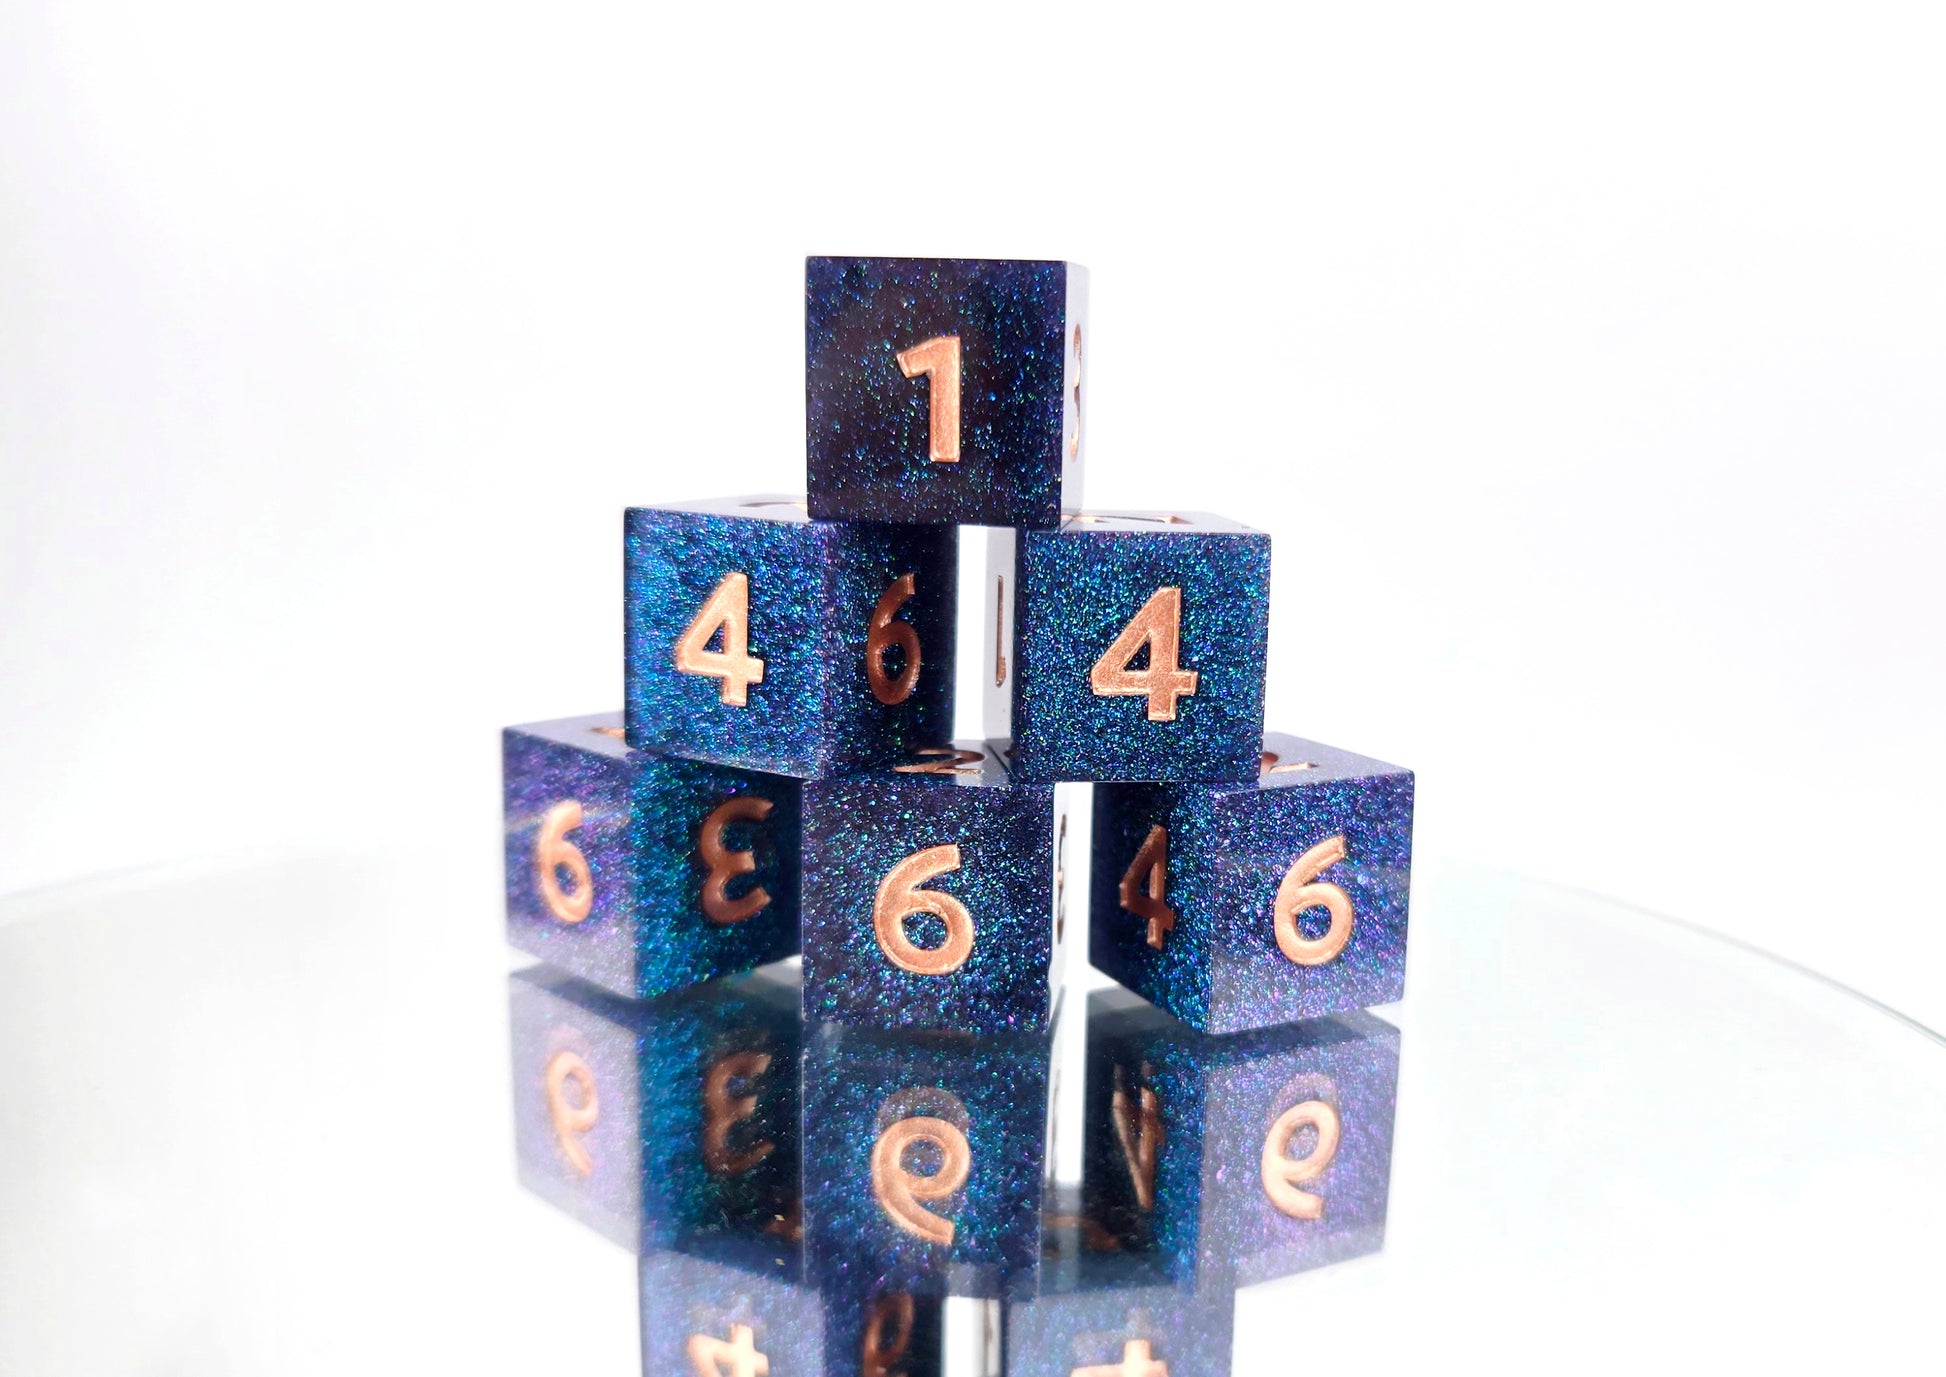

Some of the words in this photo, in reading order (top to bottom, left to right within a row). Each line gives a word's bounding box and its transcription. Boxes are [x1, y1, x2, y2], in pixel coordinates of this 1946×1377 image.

[897, 336, 961, 464] 1
[676, 572, 764, 707] 4
[867, 572, 921, 706] 6
[1090, 586, 1198, 722] 4
[537, 799, 594, 924] 6
[699, 796, 774, 926] 3
[873, 843, 975, 976] 6
[1118, 824, 1175, 951] 4
[1274, 834, 1353, 966] 6
